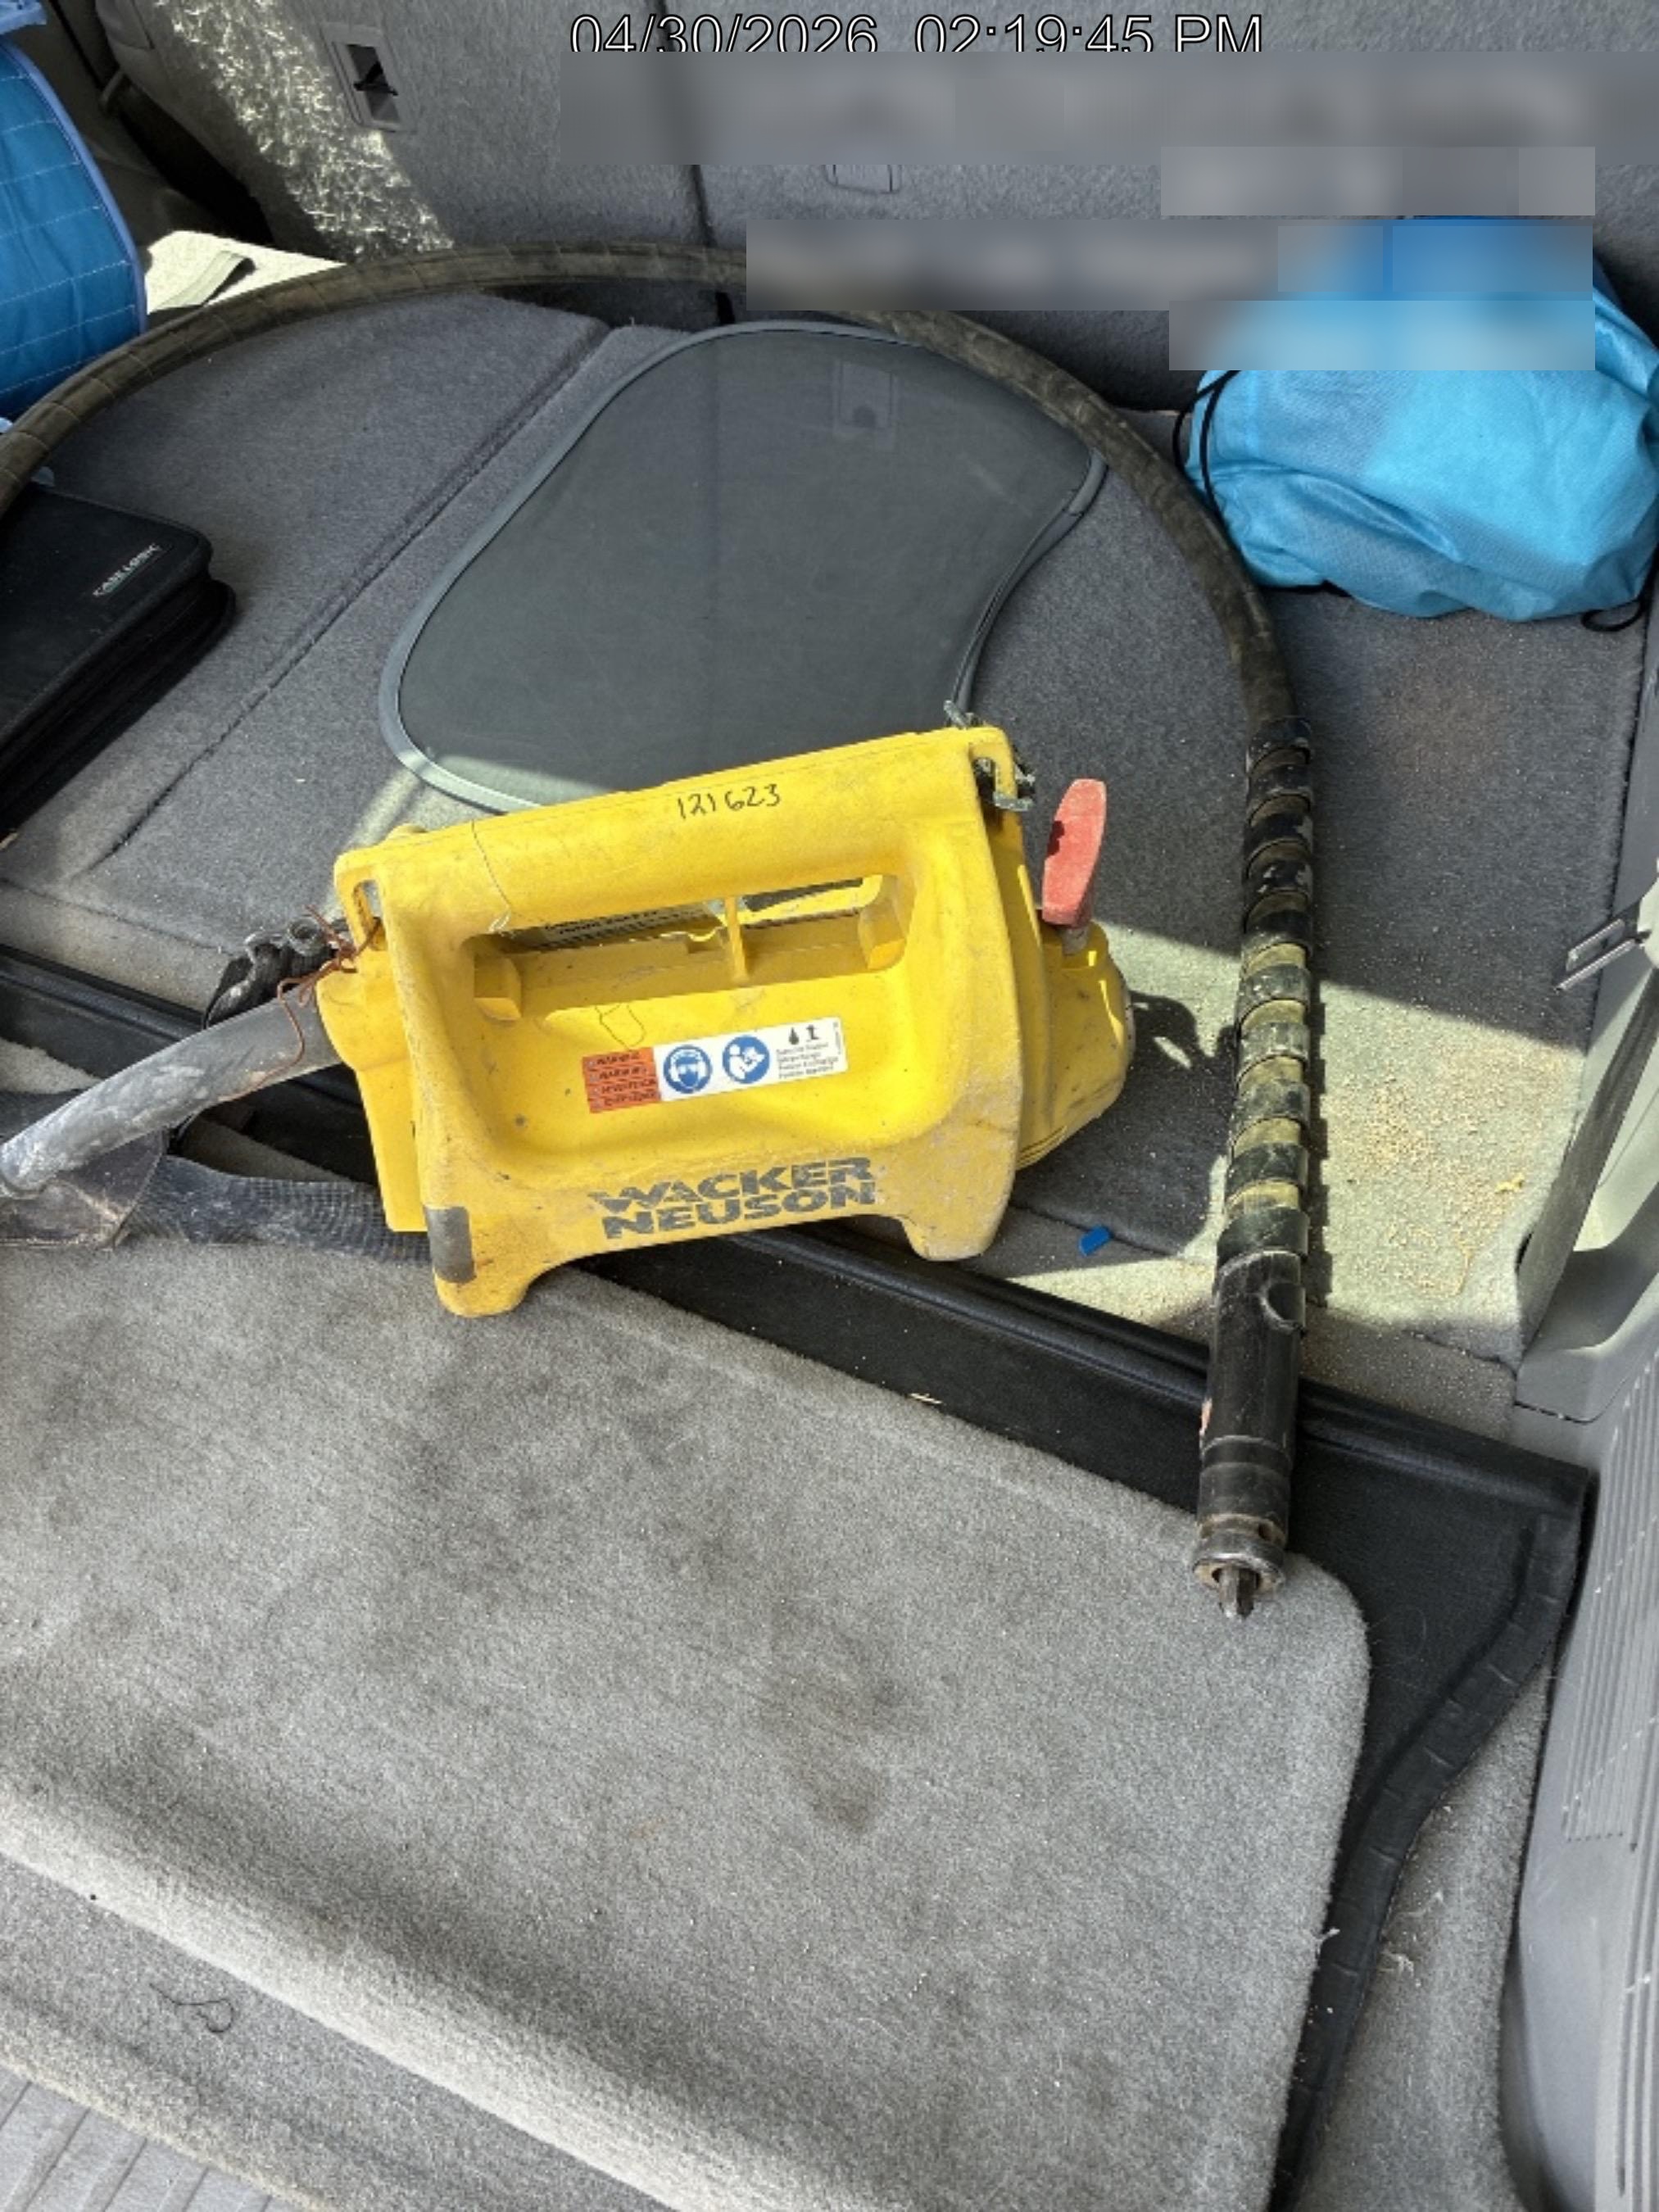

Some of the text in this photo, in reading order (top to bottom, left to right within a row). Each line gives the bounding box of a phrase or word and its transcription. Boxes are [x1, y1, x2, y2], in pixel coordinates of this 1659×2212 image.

[678, 783, 781, 819] 121623
[587, 1157, 873, 1213] WACKER
[601, 1181, 877, 1240] NEUSON
